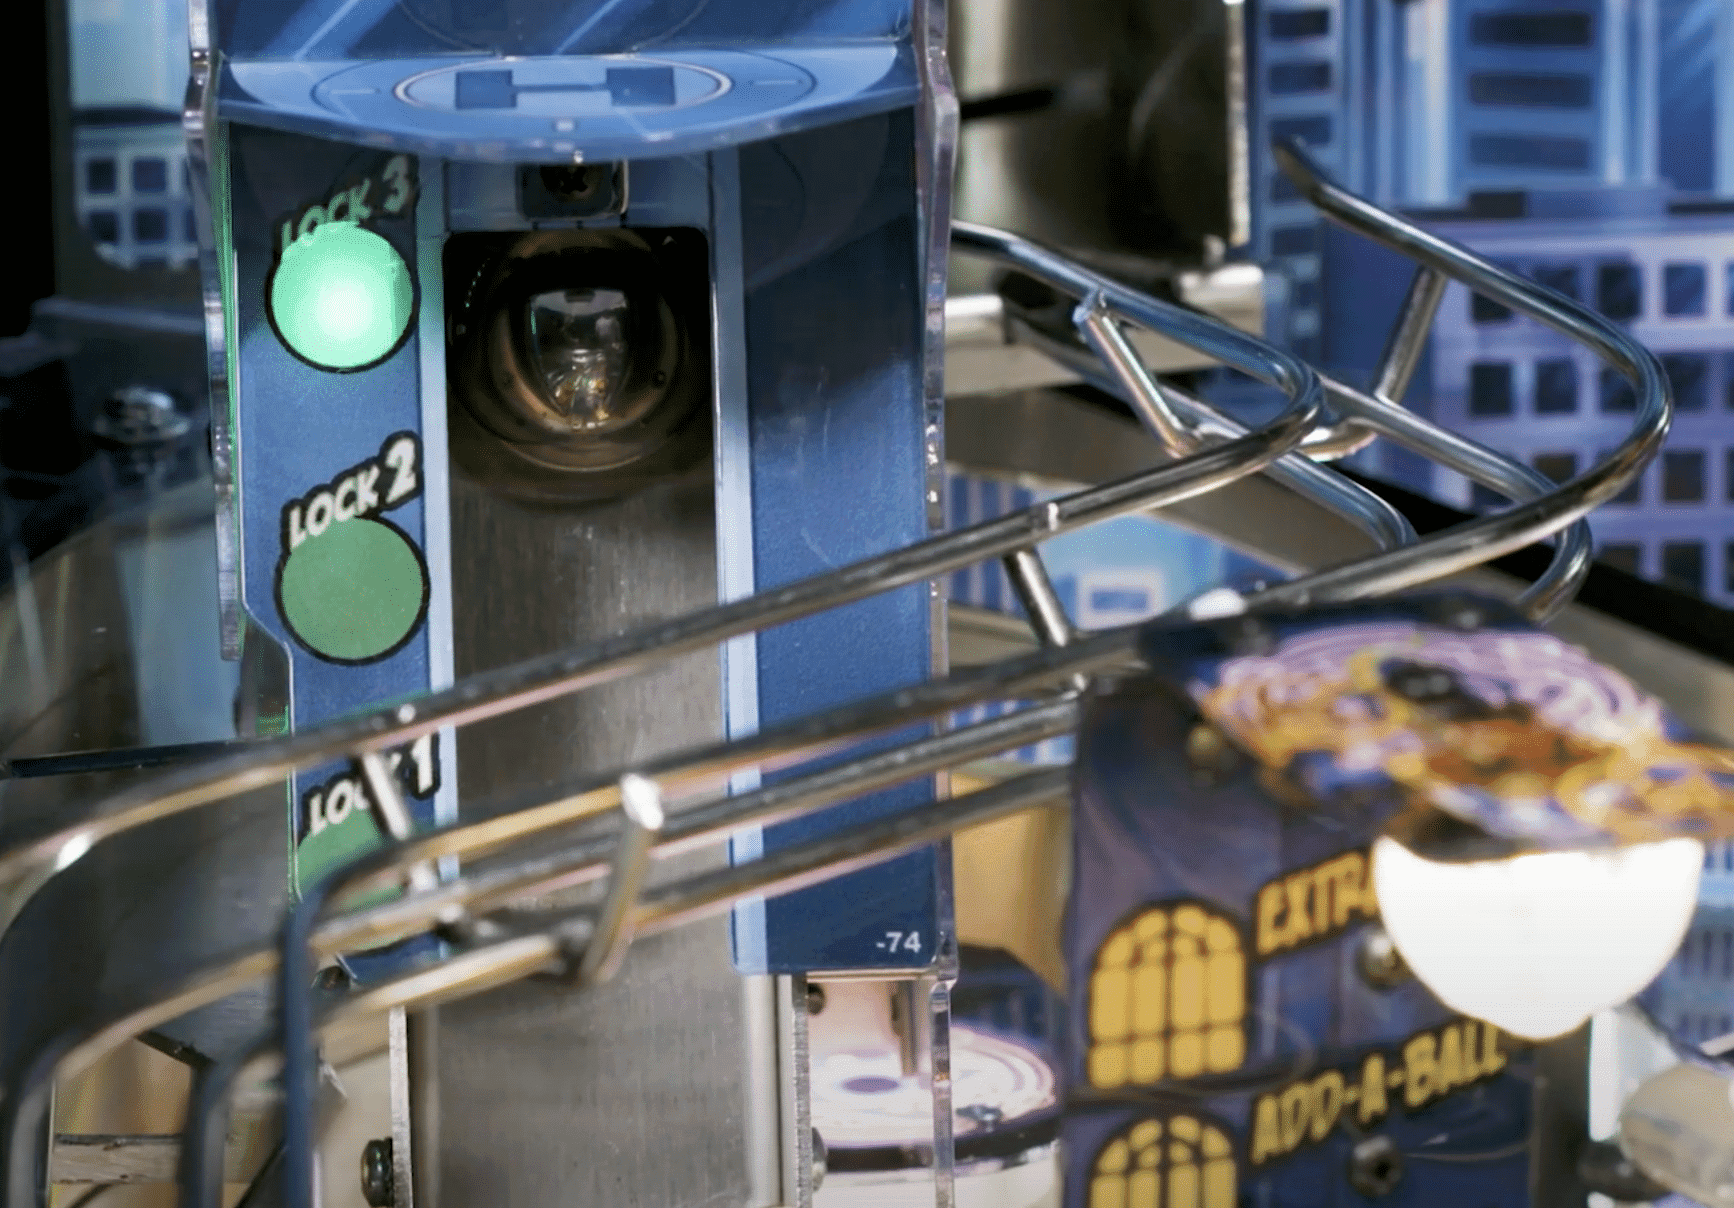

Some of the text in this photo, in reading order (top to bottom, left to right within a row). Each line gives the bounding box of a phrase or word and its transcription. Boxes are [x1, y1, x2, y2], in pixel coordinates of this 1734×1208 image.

[281, 155, 409, 250] LOCK 3
[289, 437, 417, 549] LOCK 2
[310, 733, 434, 837] LOC 1
[876, 931, 922, 953] -74
[1256, 851, 1380, 955] EXTR
[1252, 1017, 1507, 1165] ADD-A-BALL
